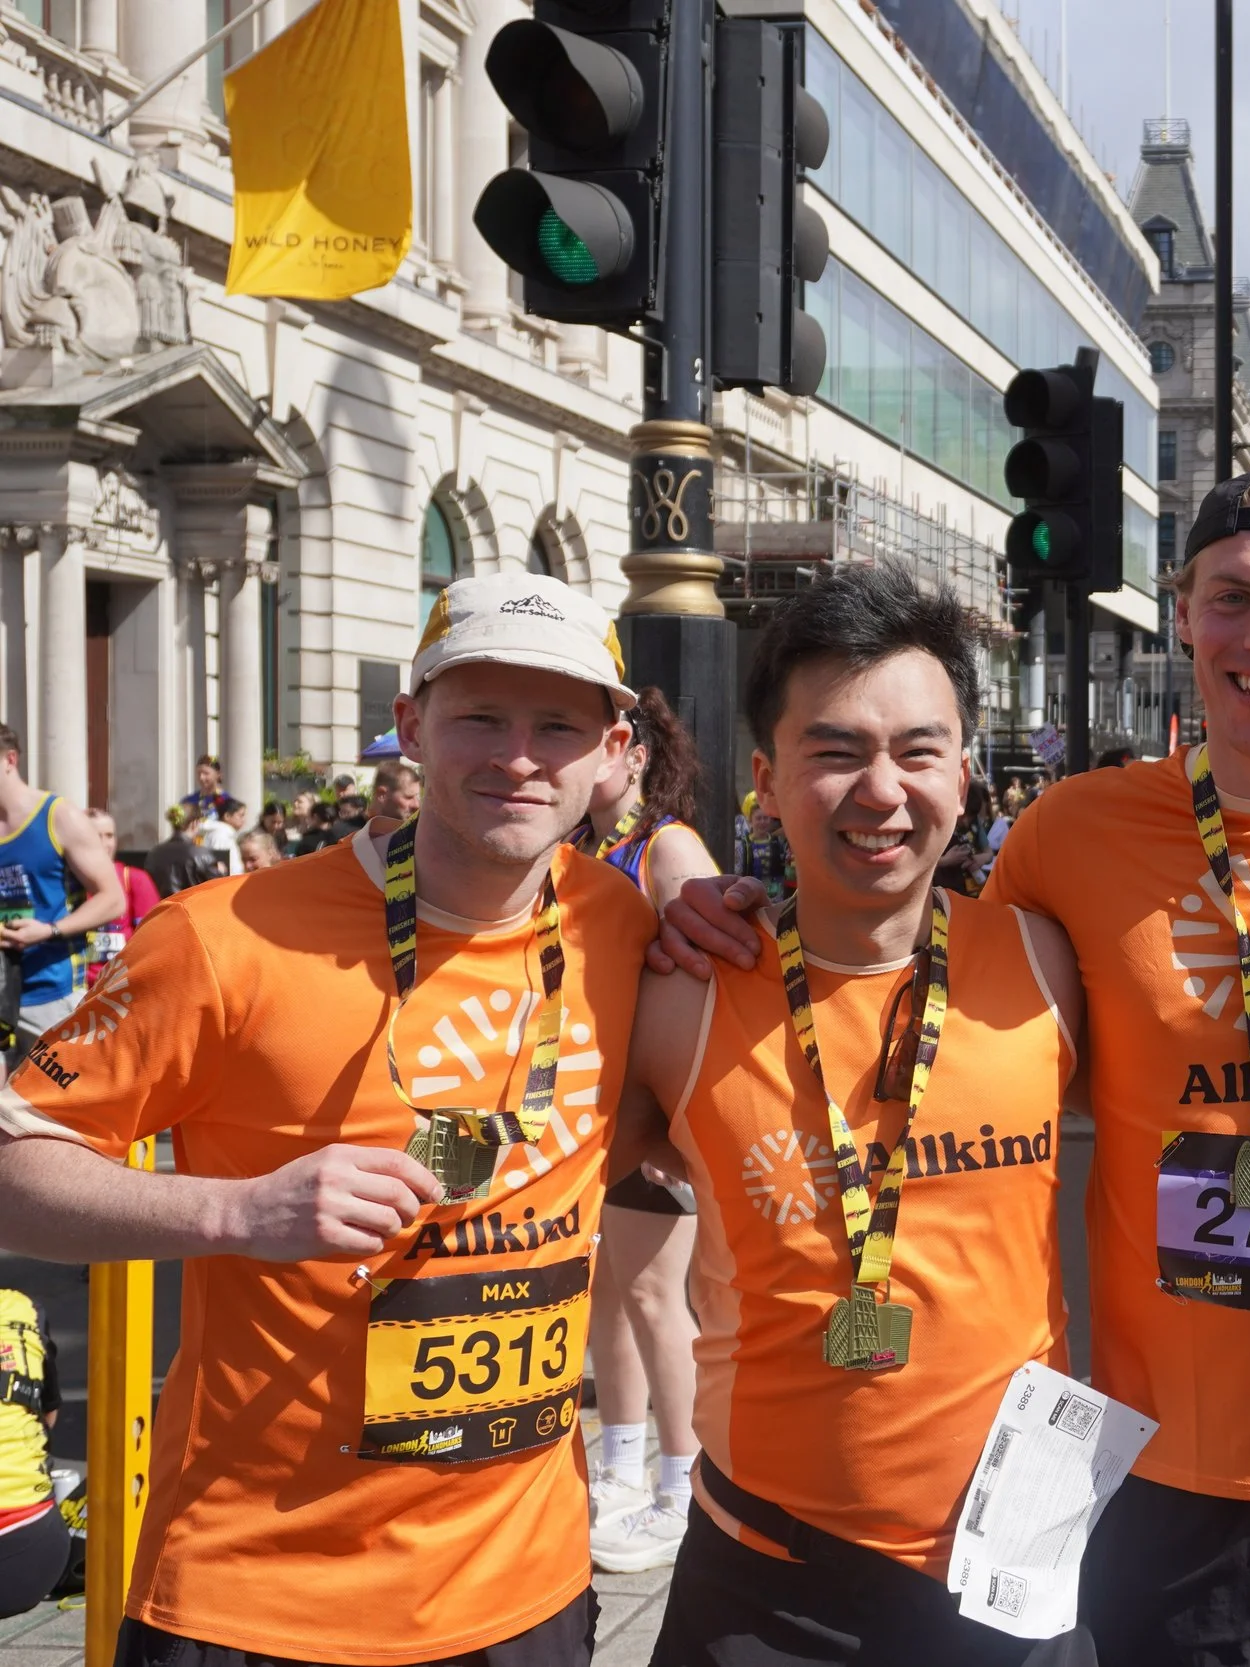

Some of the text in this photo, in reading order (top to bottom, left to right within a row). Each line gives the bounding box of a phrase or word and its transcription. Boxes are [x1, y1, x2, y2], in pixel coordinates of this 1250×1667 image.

[244, 233, 404, 253] WILD HONEY
[388, 839, 415, 857] FINISHER
[387, 917, 415, 935] FINISHER
[525, 1088, 554, 1101] FINISHER
[494, 1113, 511, 1146] FINISHER
[864, 1119, 1051, 1185] Allkind
[403, 1203, 581, 1261] Allkind
[482, 1281, 531, 1302] MAX
[1176, 1276, 1204, 1288] LONDON
[1212, 1284, 1242, 1292] LANDMARKS
[410, 1316, 568, 1401] 5313
[1017, 1384, 1035, 1411] 2389
[381, 1439, 419, 1454] LONDON
[428, 1436, 463, 1452] LANDMARKS
[960, 1557, 971, 1587] 2389
